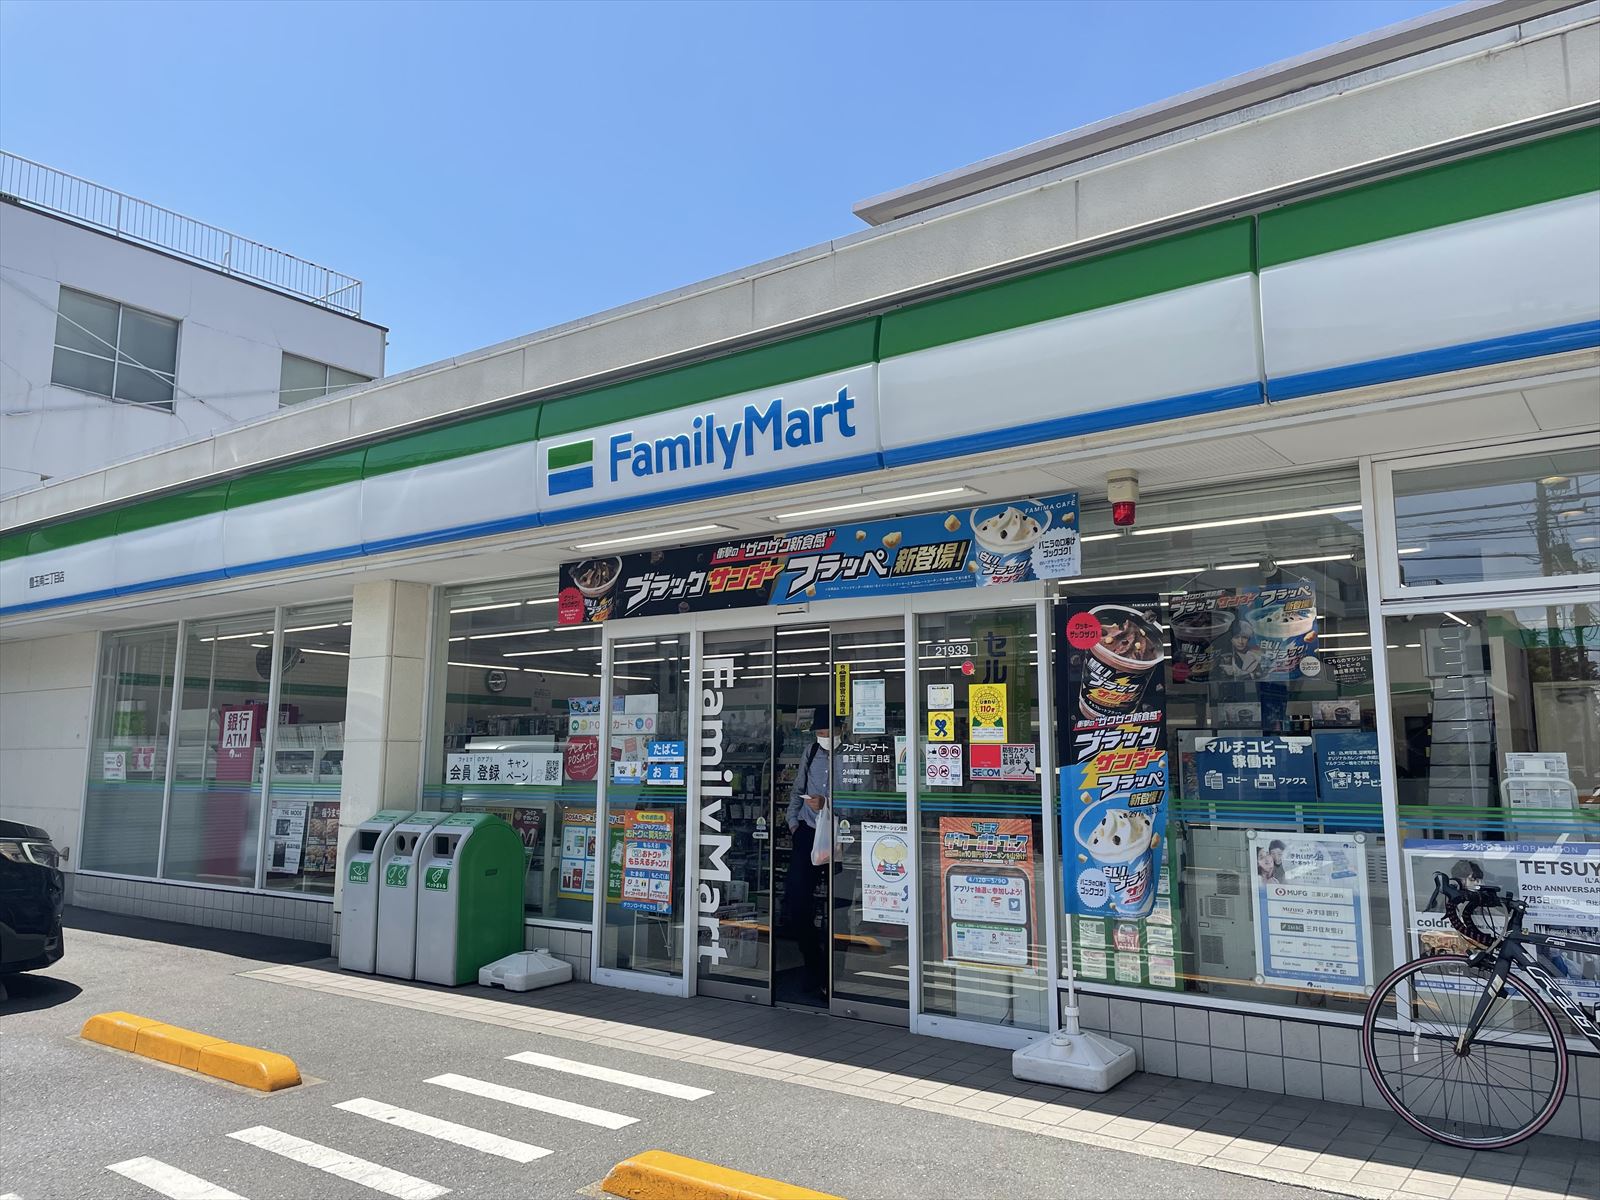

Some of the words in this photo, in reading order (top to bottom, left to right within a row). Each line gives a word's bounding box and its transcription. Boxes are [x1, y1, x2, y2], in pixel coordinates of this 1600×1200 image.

[609, 385, 856, 482] FamilyMart
[1025, 505, 1054, 514] FAMIMA
[1056, 500, 1076, 509] CAFÉ
[979, 551, 1000, 565] 白い
[624, 570, 706, 614] ブラック
[709, 561, 784, 593] サンダー
[787, 552, 887, 598] フラッペ
[894, 544, 966, 574] 新登場!
[1260, 585, 1312, 606] フラッペ
[935, 645, 969, 656] 21939
[228, 712, 250, 731] 銀行
[613, 720, 634, 729] カード
[226, 733, 248, 747] ATM
[1076, 727, 1158, 760] ブラック
[653, 743, 679, 755] たばこ
[842, 744, 889, 752] ファミリーマート
[1206, 741, 1304, 754] マルチコピー機
[842, 754, 890, 763] 豊玉南三丁目店
[1096, 748, 1164, 772] サンダー
[1232, 755, 1276, 769] 稼働中
[450, 765, 471, 780] 会員
[477, 764, 500, 780] 登録
[507, 758, 529, 768] キャン
[653, 767, 662, 778] お
[670, 766, 679, 778] 酒
[972, 768, 1000, 777] SECOM
[1353, 771, 1370, 779] 写真
[506, 772, 528, 781] ペーン
[1227, 776, 1248, 784] コピー
[1279, 777, 1307, 785] ファクス
[1098, 771, 1164, 799] フラッペ
[1130, 791, 1165, 806] 新登場!
[953, 885, 1023, 896] アプリで抽選に参加しよう!
[1287, 889, 1308, 897] MUFG
[1522, 884, 1541, 892] 20th
